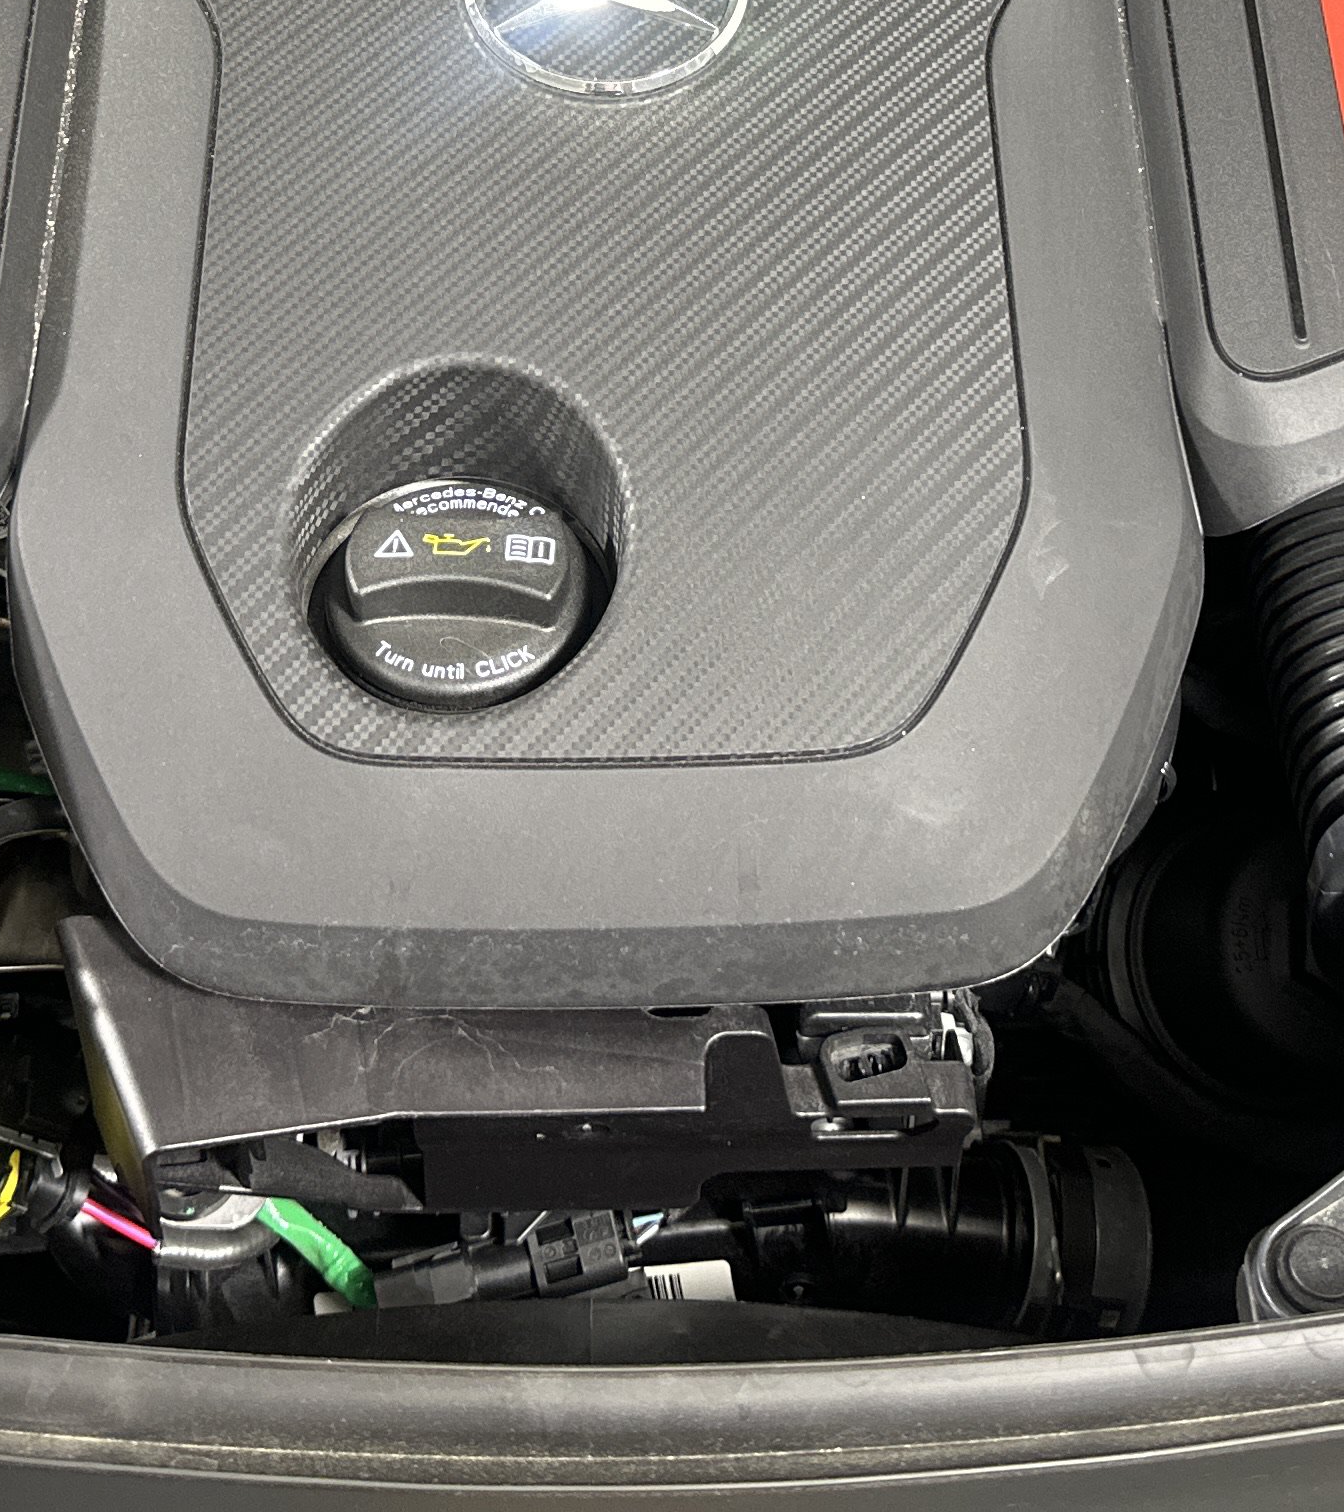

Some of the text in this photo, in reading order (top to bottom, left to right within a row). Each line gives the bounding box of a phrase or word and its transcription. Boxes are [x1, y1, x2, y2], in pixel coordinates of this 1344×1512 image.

[410, 497, 520, 518] ecommende
[375, 639, 536, 680] Turn until CLICK
